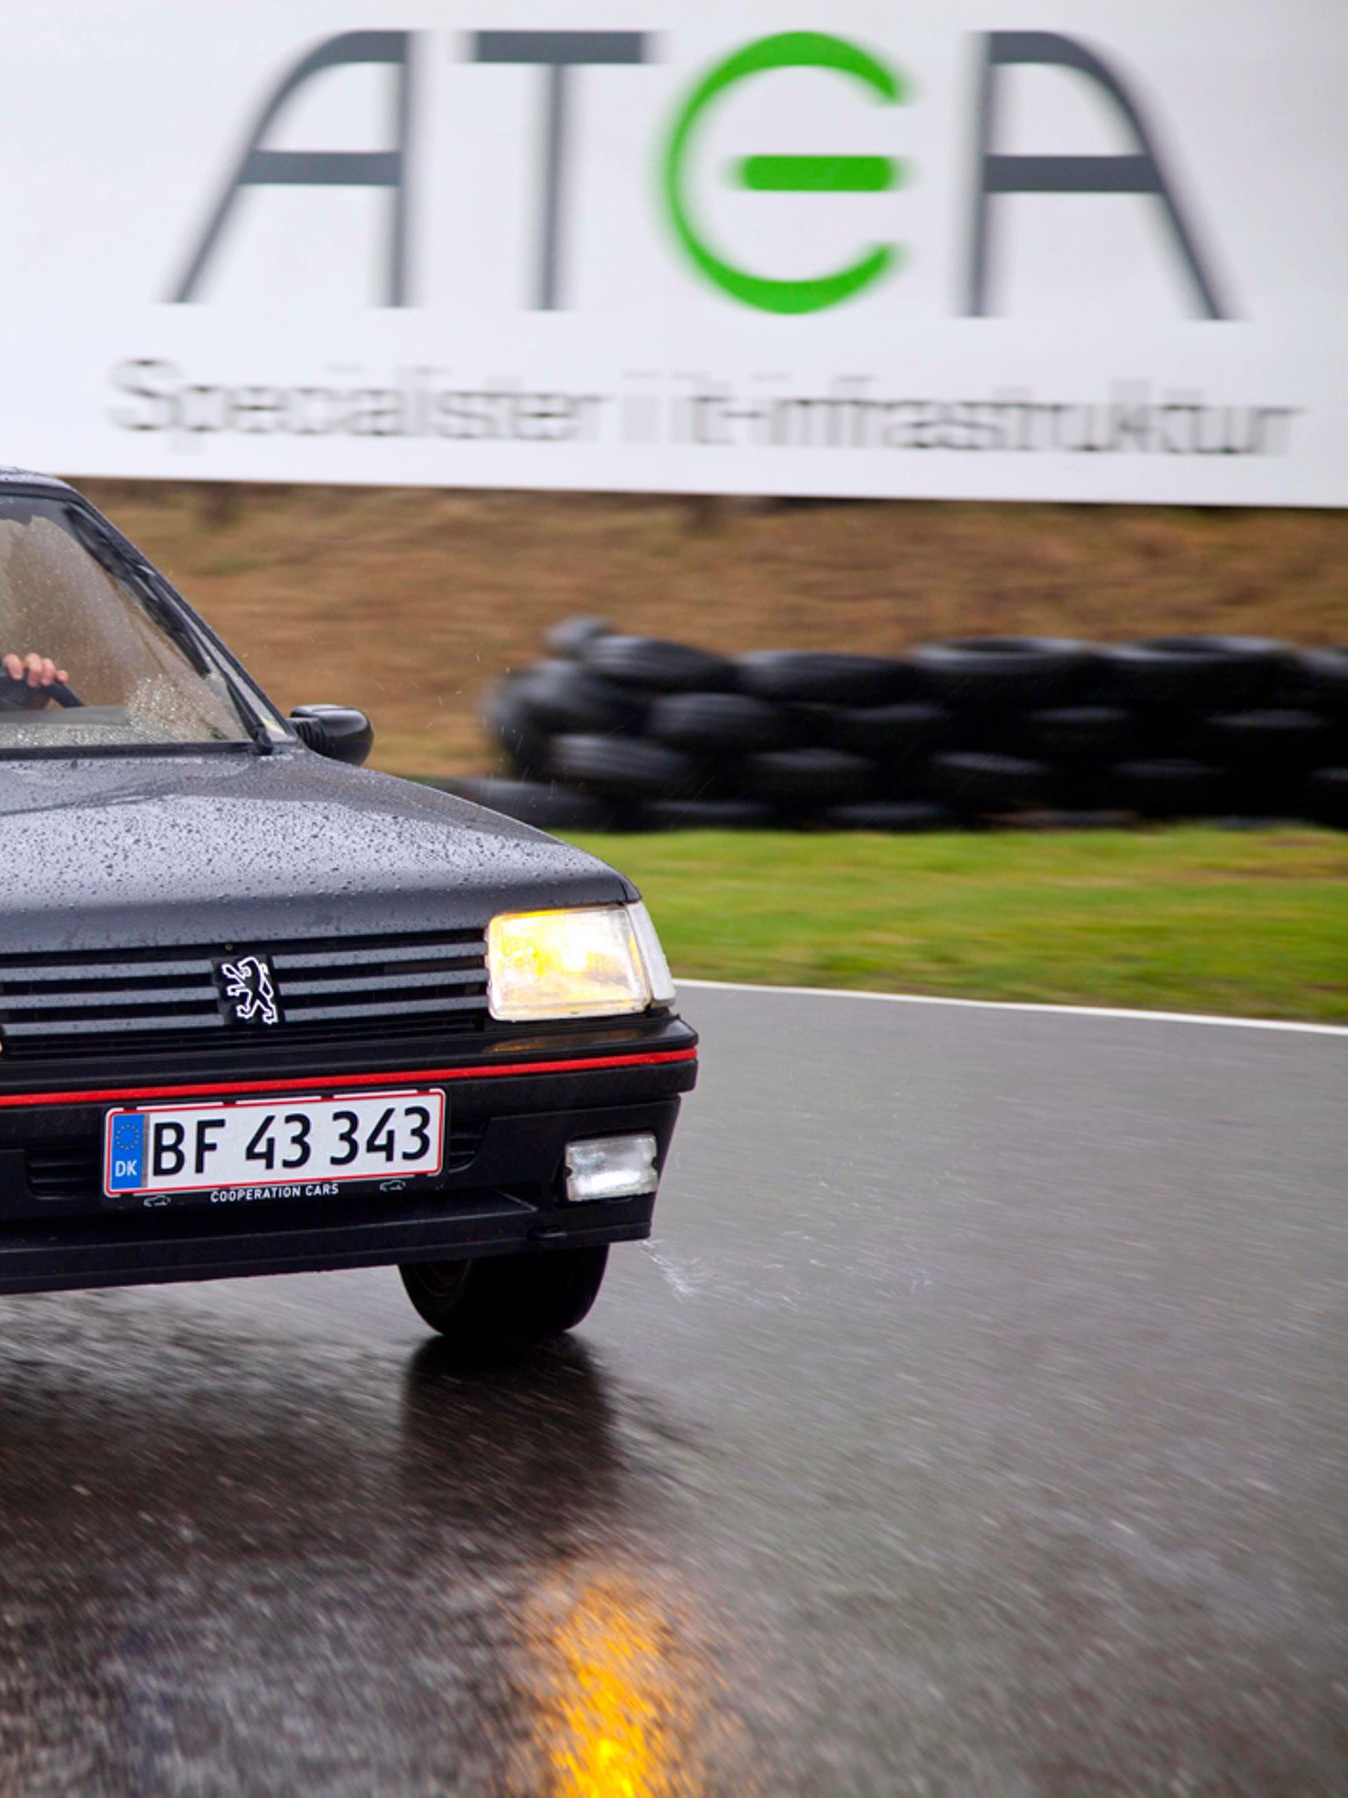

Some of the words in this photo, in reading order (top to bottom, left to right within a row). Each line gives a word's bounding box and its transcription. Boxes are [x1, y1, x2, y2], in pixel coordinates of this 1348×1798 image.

[157, 28, 1252, 321] ATEA
[108, 357, 610, 454] Specialister
[670, 371, 1304, 456] it-infrastruktur
[114, 1159, 138, 1177] DK
[152, 1117, 227, 1177] BF
[245, 1113, 312, 1170] 43
[330, 1105, 432, 1166] 343
[210, 1185, 302, 1203] COOPERATION
[304, 1182, 340, 1197] CARS
